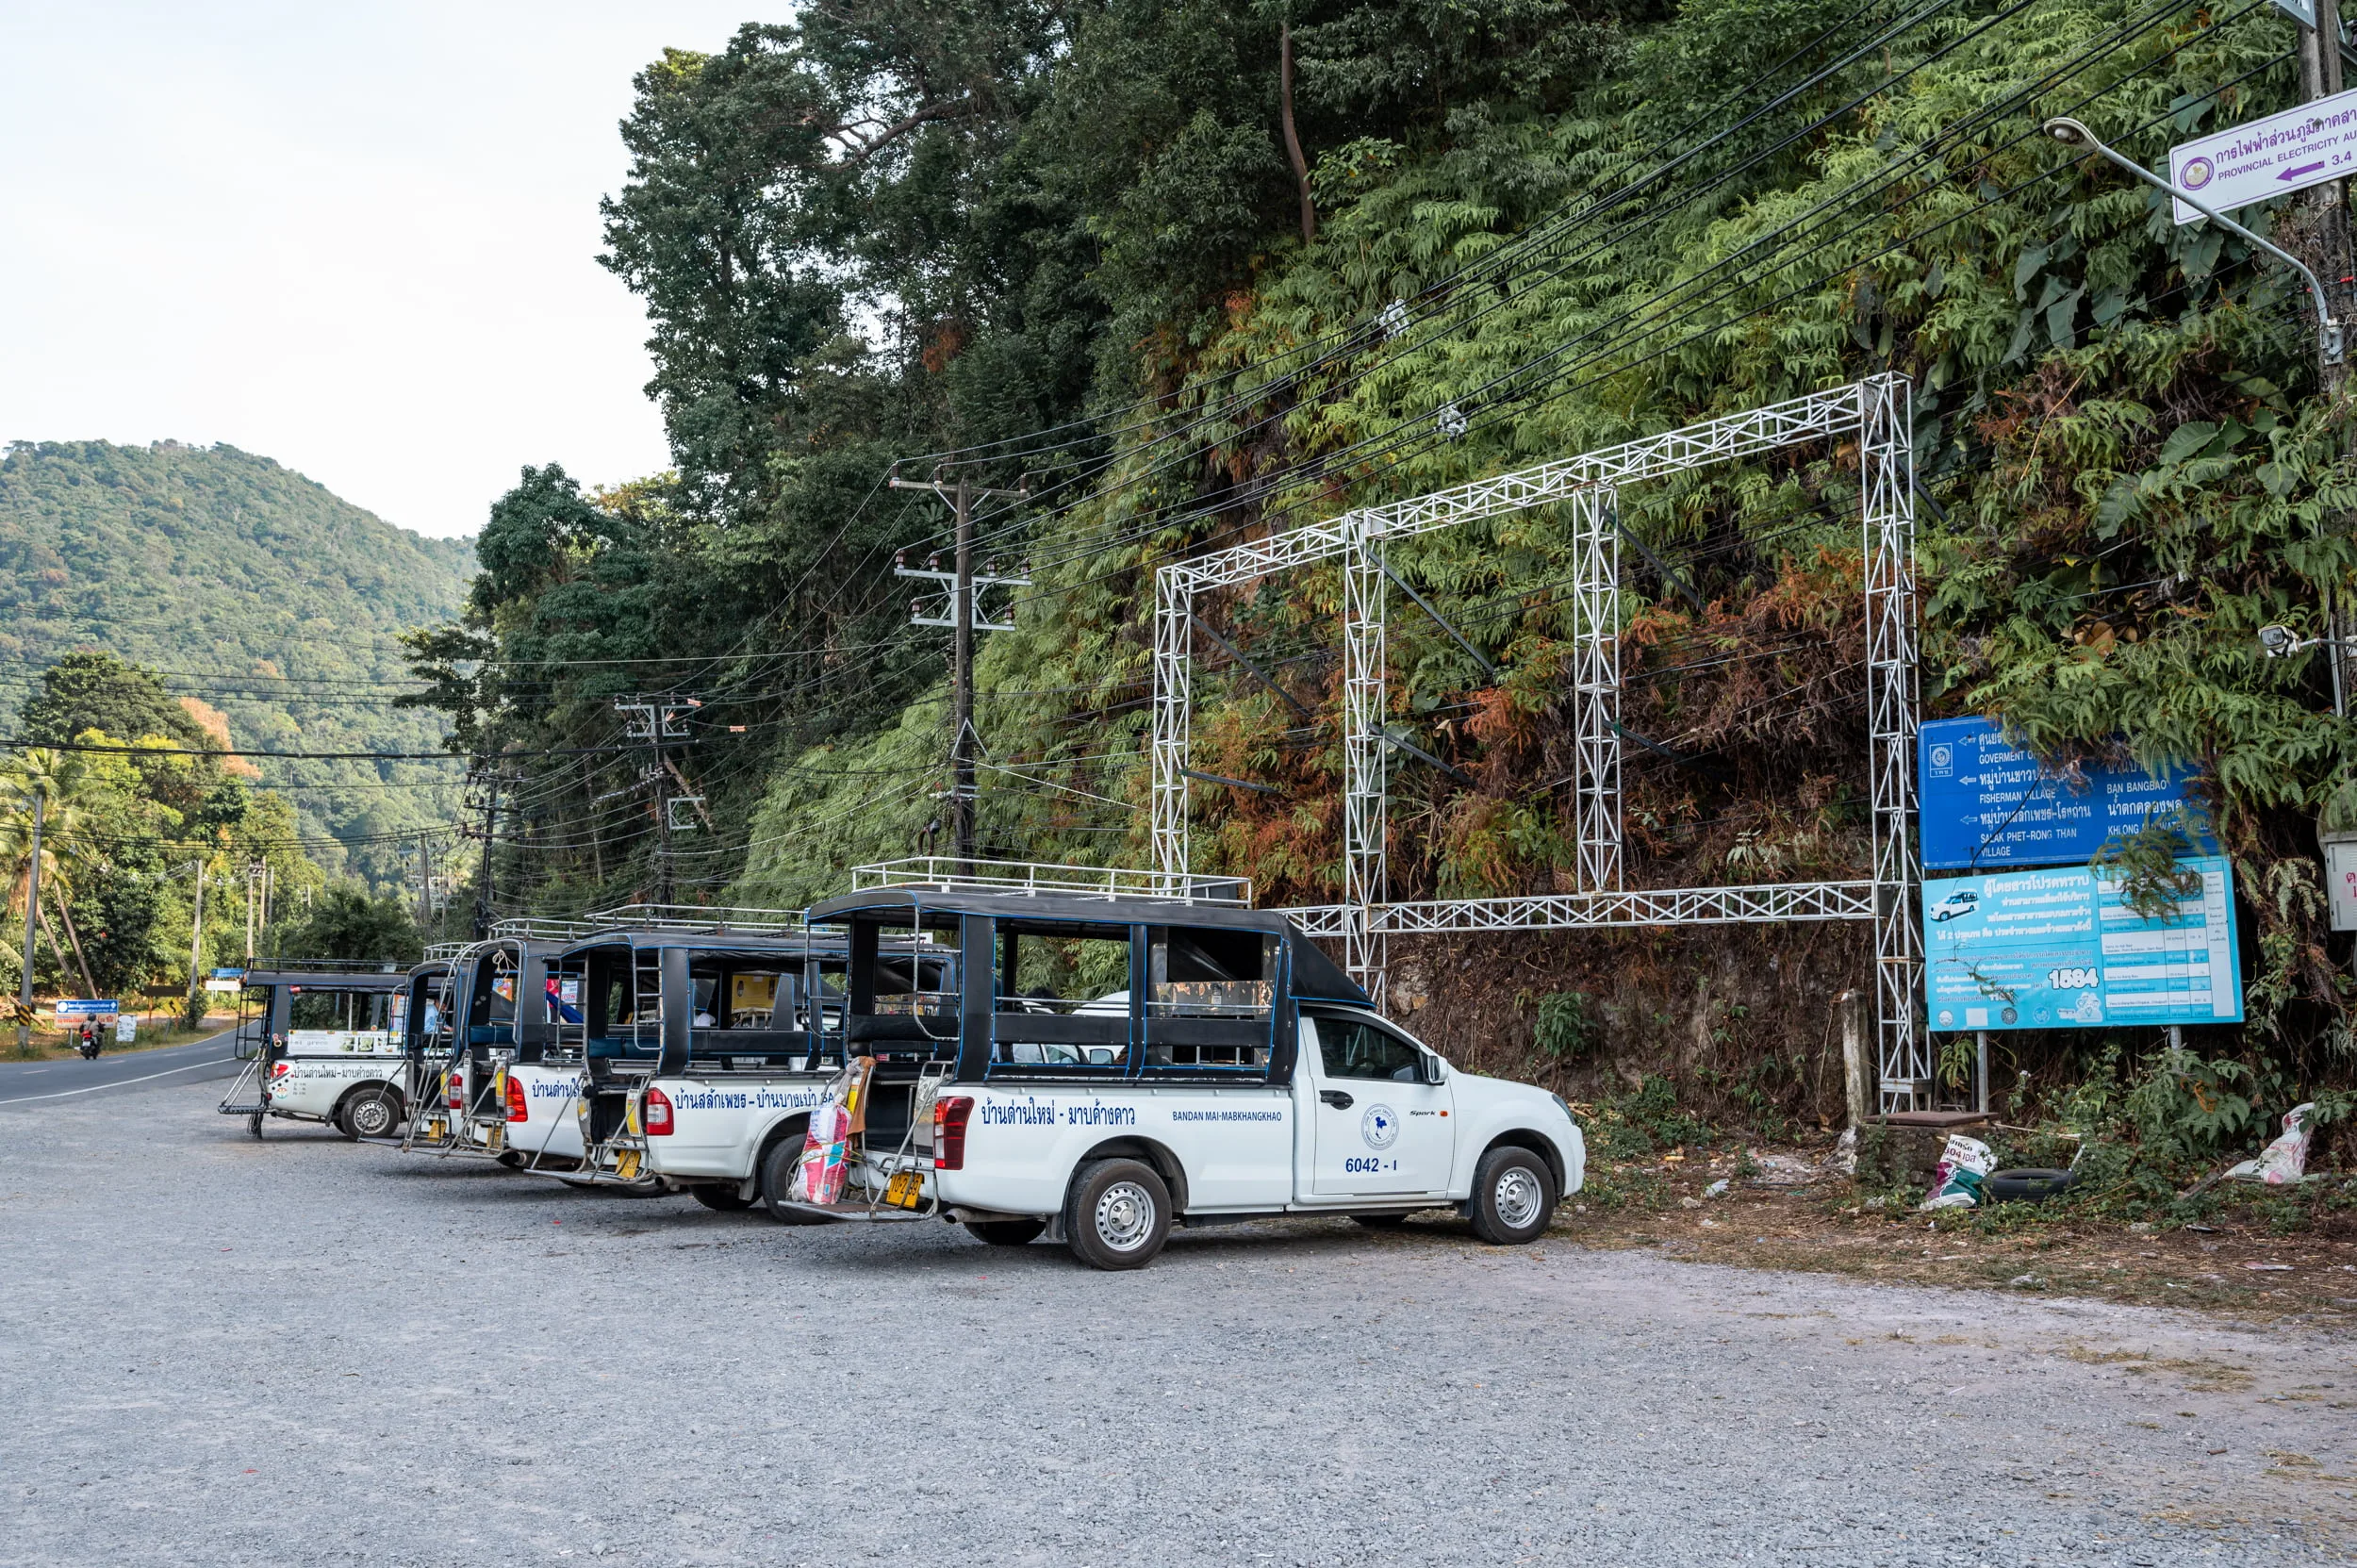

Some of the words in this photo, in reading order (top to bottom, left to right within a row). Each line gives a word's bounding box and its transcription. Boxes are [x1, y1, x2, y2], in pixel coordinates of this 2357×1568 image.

[2218, 157, 2274, 181] PROVINCIAL
[2277, 136, 2339, 162] ELECTRICITY
[2332, 151, 2352, 166] 3.4
[1979, 751, 2025, 765] GOVERMENT
[2106, 784, 2124, 794] BAN
[2126, 779, 2167, 793] BANGBAO
[1980, 790, 2022, 803] FISHERMAN
[2024, 787, 2056, 801] VILLAGE
[1980, 833, 2004, 844] SALAK
[2006, 830, 2052, 841] PHET-RONG
[2056, 828, 2077, 838] THAN
[1981, 846, 2011, 857] VILLAGE
[2048, 966, 2100, 990] 1584
[675, 1087, 747, 1109] บ้านสลักเพชร
[981, 1097, 1055, 1125] บ้านด่านใหม่
[1068, 1098, 1135, 1125] มาบค้างคาว
[1172, 1111, 1204, 1121] BANDAN
[1205, 1111, 1282, 1121] MAI-MABKHANGKHAO
[1345, 1158, 1379, 1172] 6042
